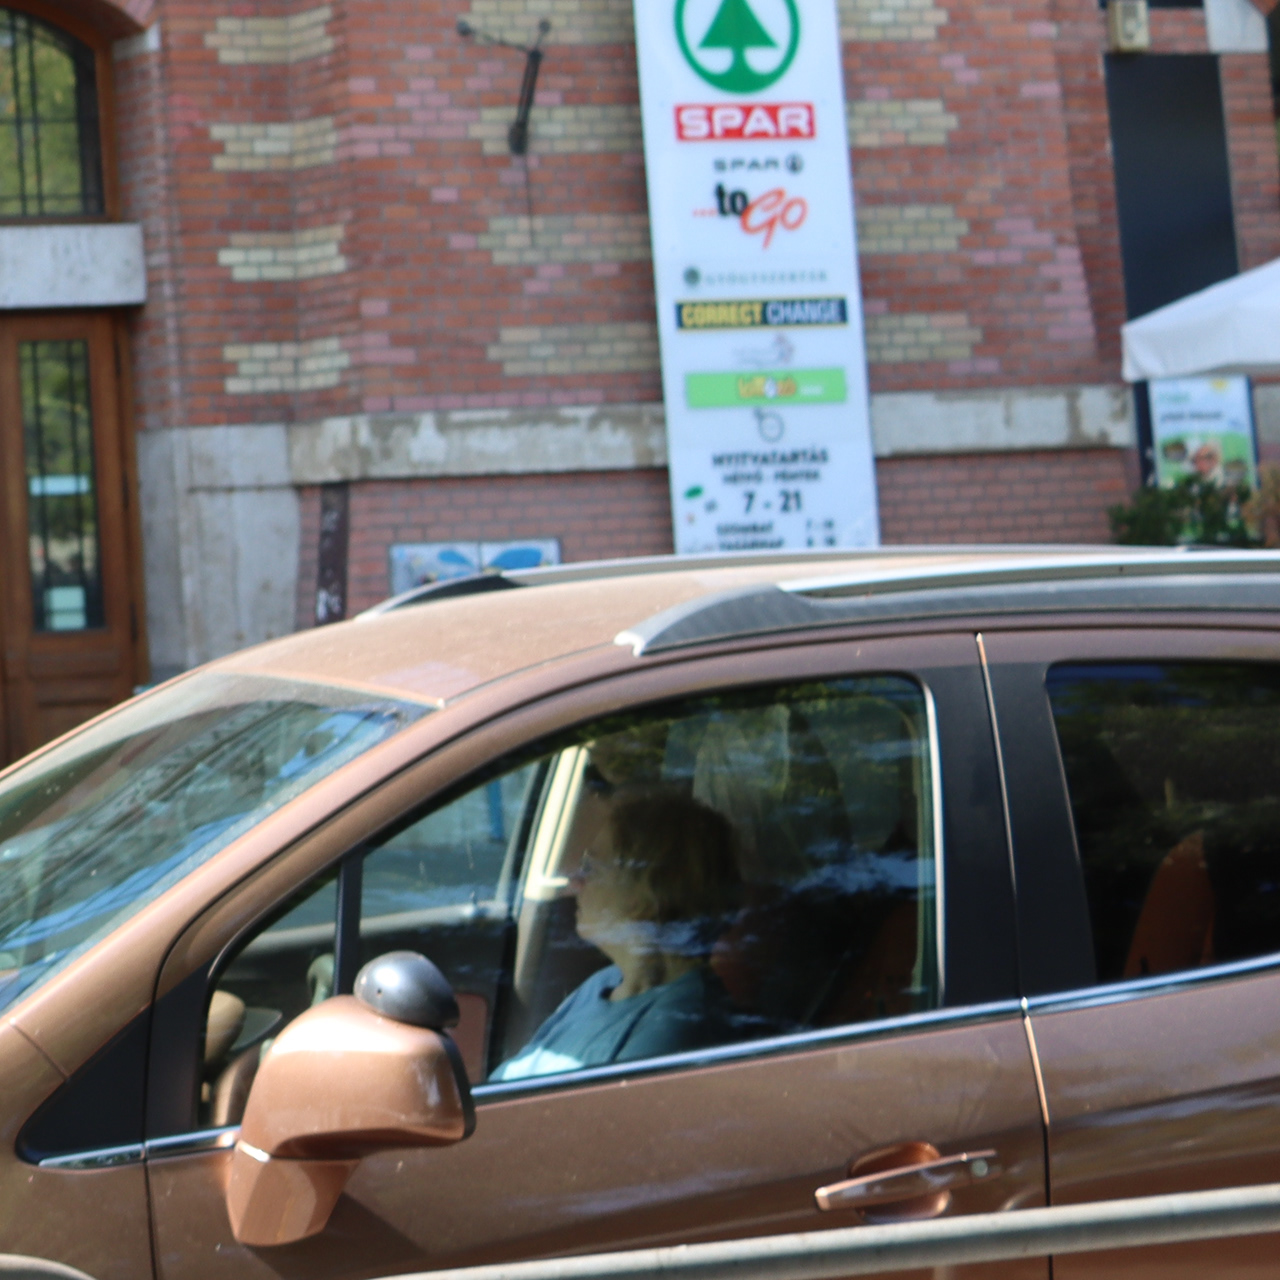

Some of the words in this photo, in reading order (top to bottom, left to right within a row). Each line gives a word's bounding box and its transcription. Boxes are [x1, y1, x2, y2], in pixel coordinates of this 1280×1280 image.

[679, 103, 810, 141] SPAR
[714, 158, 780, 171] SPAR
[681, 301, 763, 327] CORRECT
[766, 298, 841, 325] CHANGE
[744, 490, 755, 513] 7
[780, 489, 802, 512] 21
